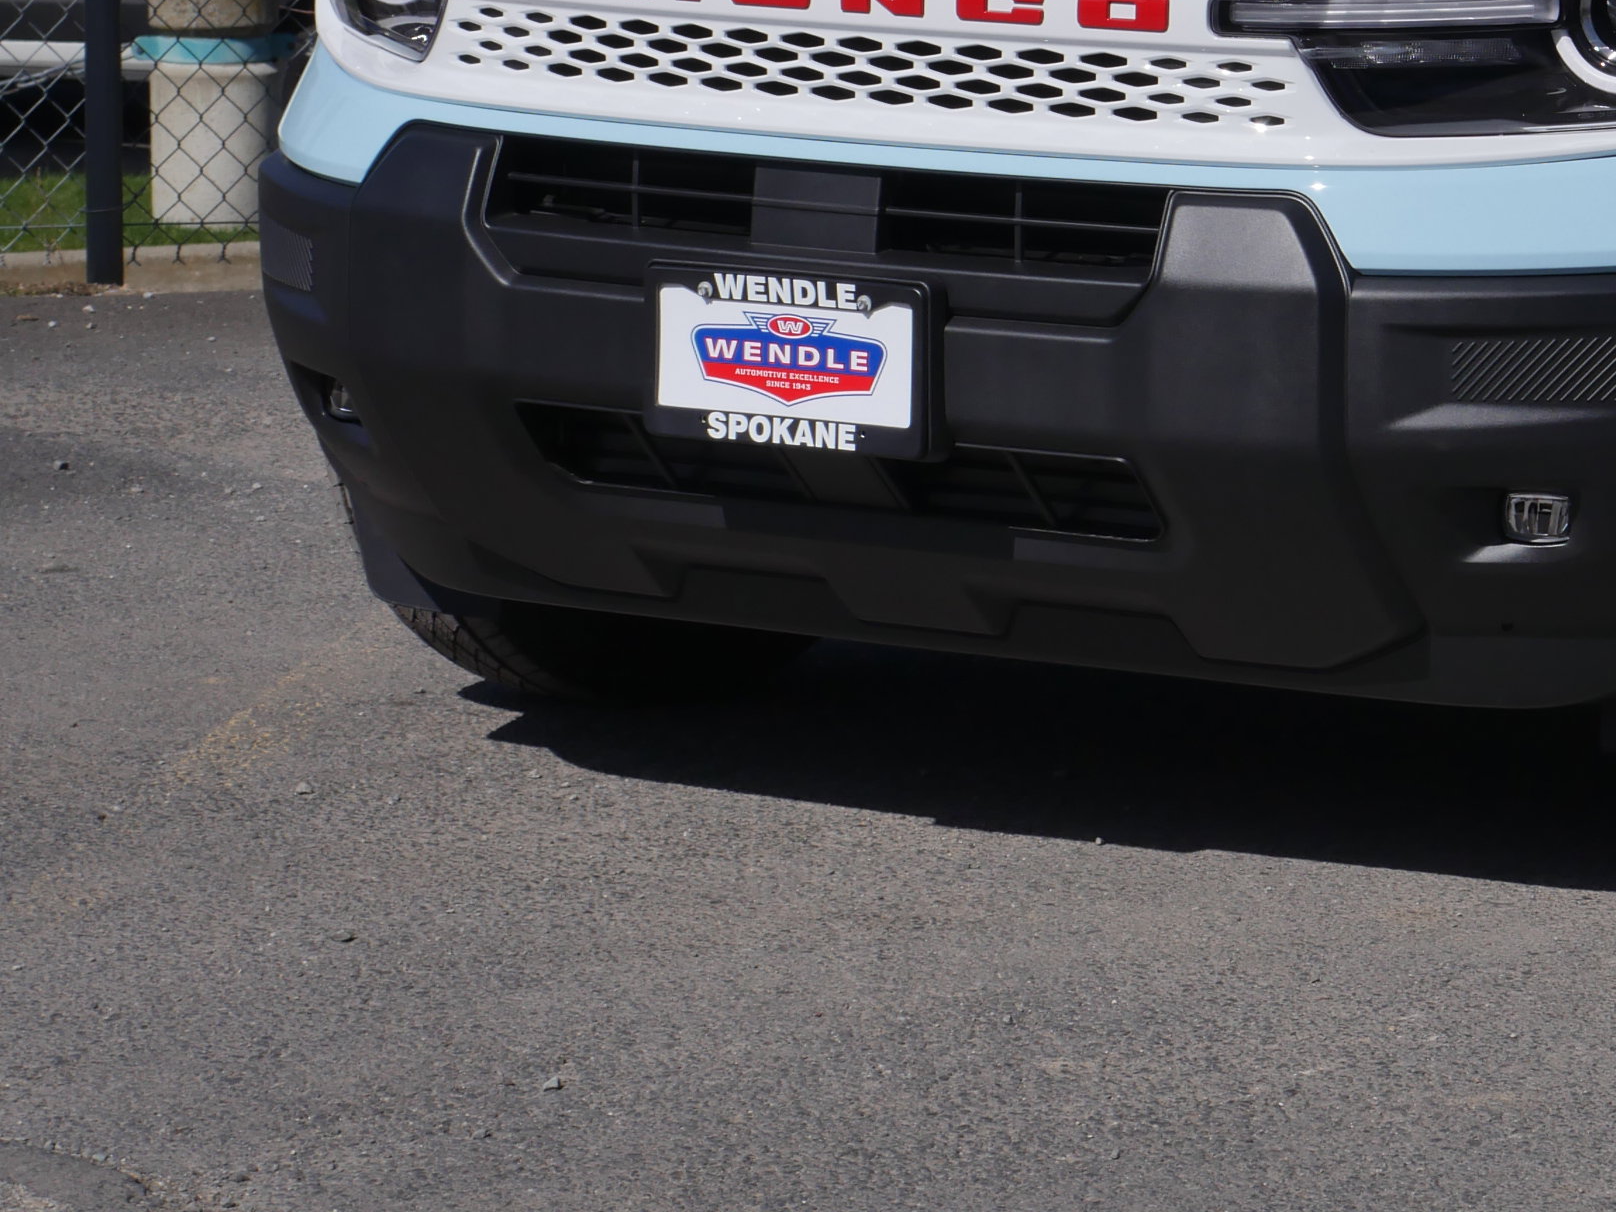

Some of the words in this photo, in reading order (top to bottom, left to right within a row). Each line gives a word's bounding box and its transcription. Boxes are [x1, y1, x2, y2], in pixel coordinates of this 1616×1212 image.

[714, 273, 857, 311] WENDLE
[777, 320, 803, 335] W
[705, 338, 868, 371] WENDLE
[735, 368, 787, 379] AUTOMOTIVE
[789, 373, 839, 384] EXCELLENCE
[766, 380, 790, 389] SINCE
[793, 383, 811, 391] 1943
[707, 412, 856, 451] SPOKANE
